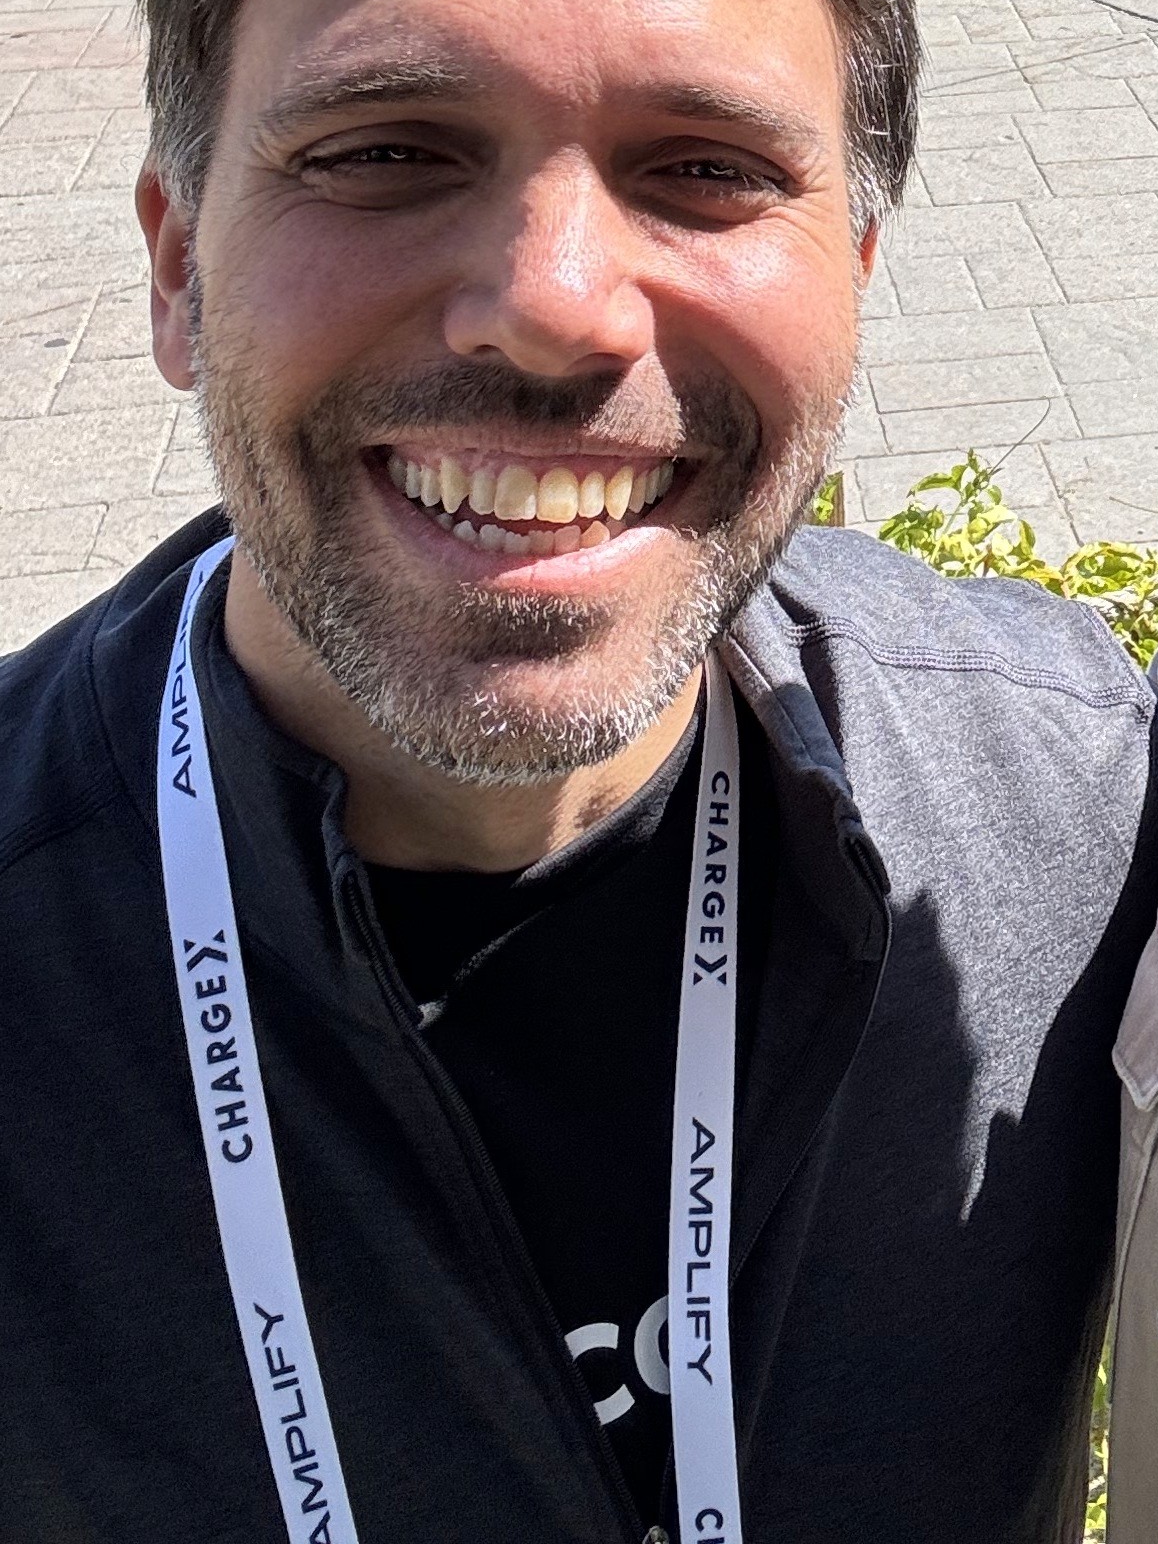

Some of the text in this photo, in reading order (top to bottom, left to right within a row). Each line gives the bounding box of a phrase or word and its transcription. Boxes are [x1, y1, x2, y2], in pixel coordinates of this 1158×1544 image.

[692, 770, 731, 986] CHARGEX
[183, 929, 253, 1163] CHARGEX
[686, 1117, 716, 1386] AMPLIFY
[695, 1508, 725, 1544] C
